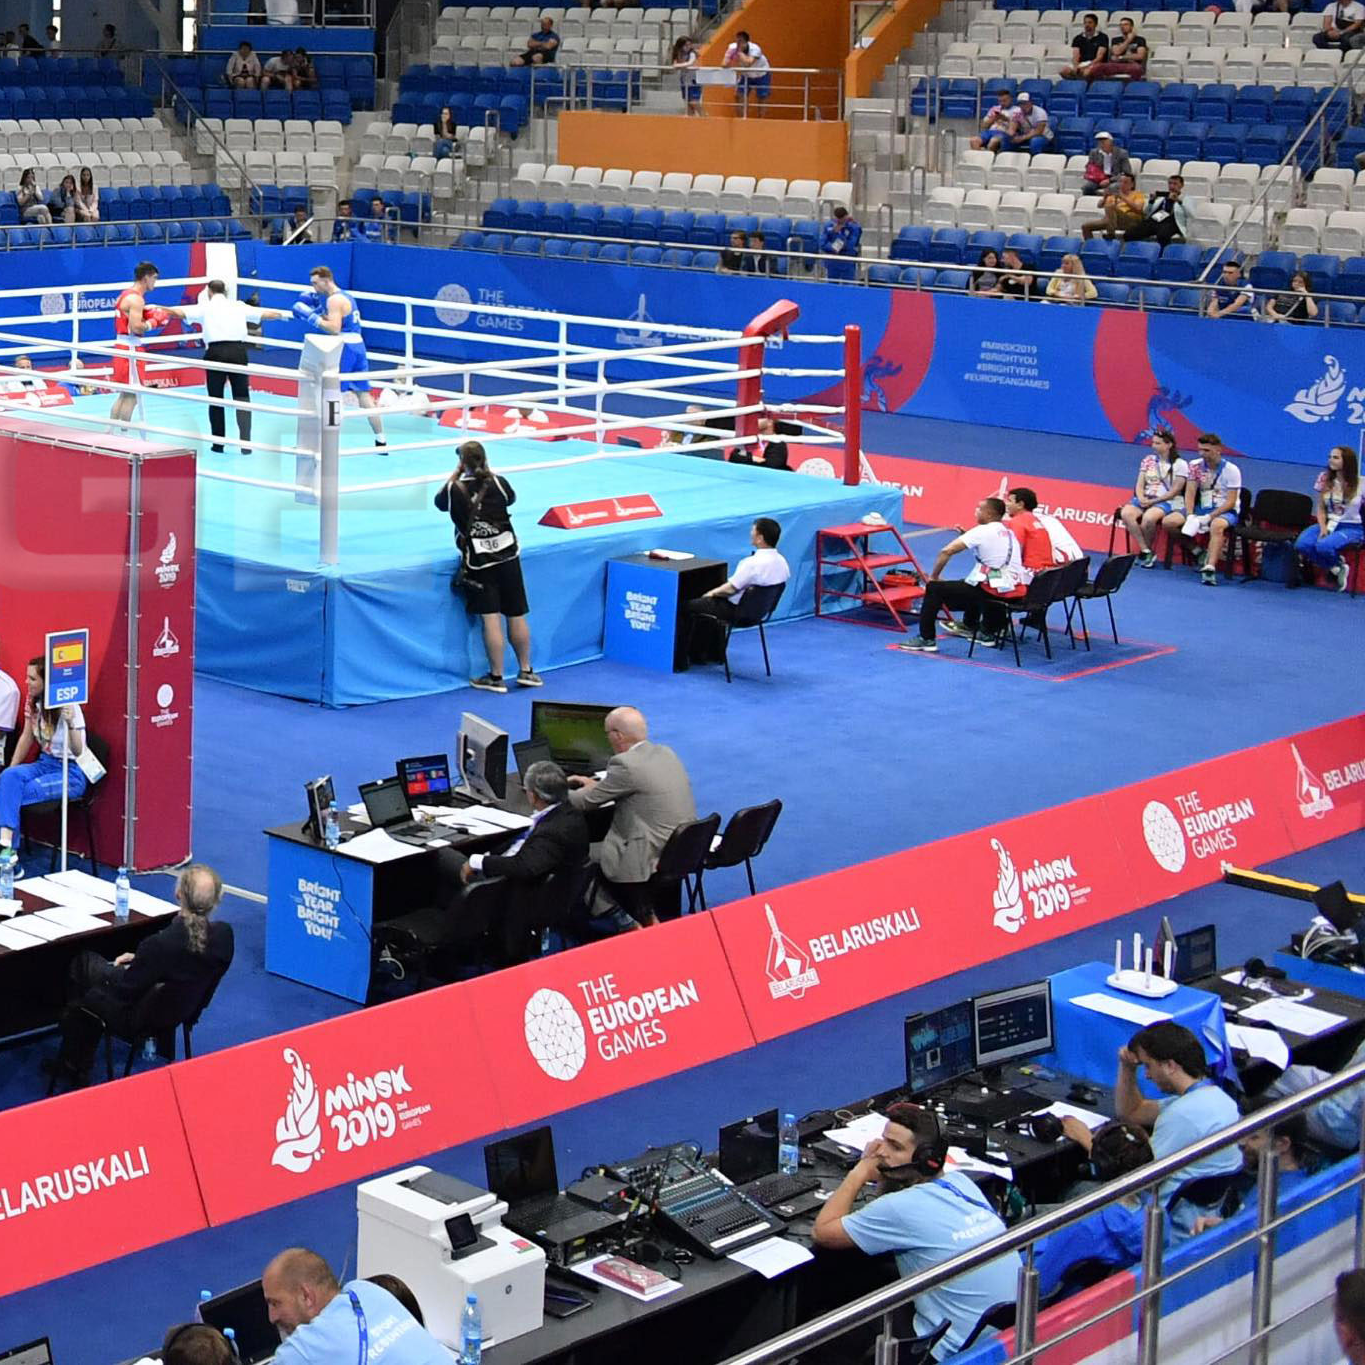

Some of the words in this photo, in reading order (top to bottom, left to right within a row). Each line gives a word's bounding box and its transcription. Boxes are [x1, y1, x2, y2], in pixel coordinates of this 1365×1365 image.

[476, 315, 524, 331] GAMES
[56, 686, 78, 702] ESP
[1323, 760, 1365, 792] BELARU
[1175, 791, 1203, 815] THE
[1183, 798, 1256, 838] EUROPEAN
[1191, 827, 1238, 859] GAMES
[1021, 854, 1079, 892] MINSK
[298, 877, 342, 903] BRIGHT
[1028, 883, 1071, 920] 2019
[297, 903, 341, 929] BRIGHT
[809, 907, 920, 963] BELARUSKALI
[578, 973, 621, 1002] THE
[587, 978, 700, 1035] EUROPEAN
[597, 1018, 667, 1061] GAMES
[325, 1064, 413, 1117] MINSK
[331, 1100, 397, 1152] 2019
[398, 1103, 431, 1122] EUROPEAN
